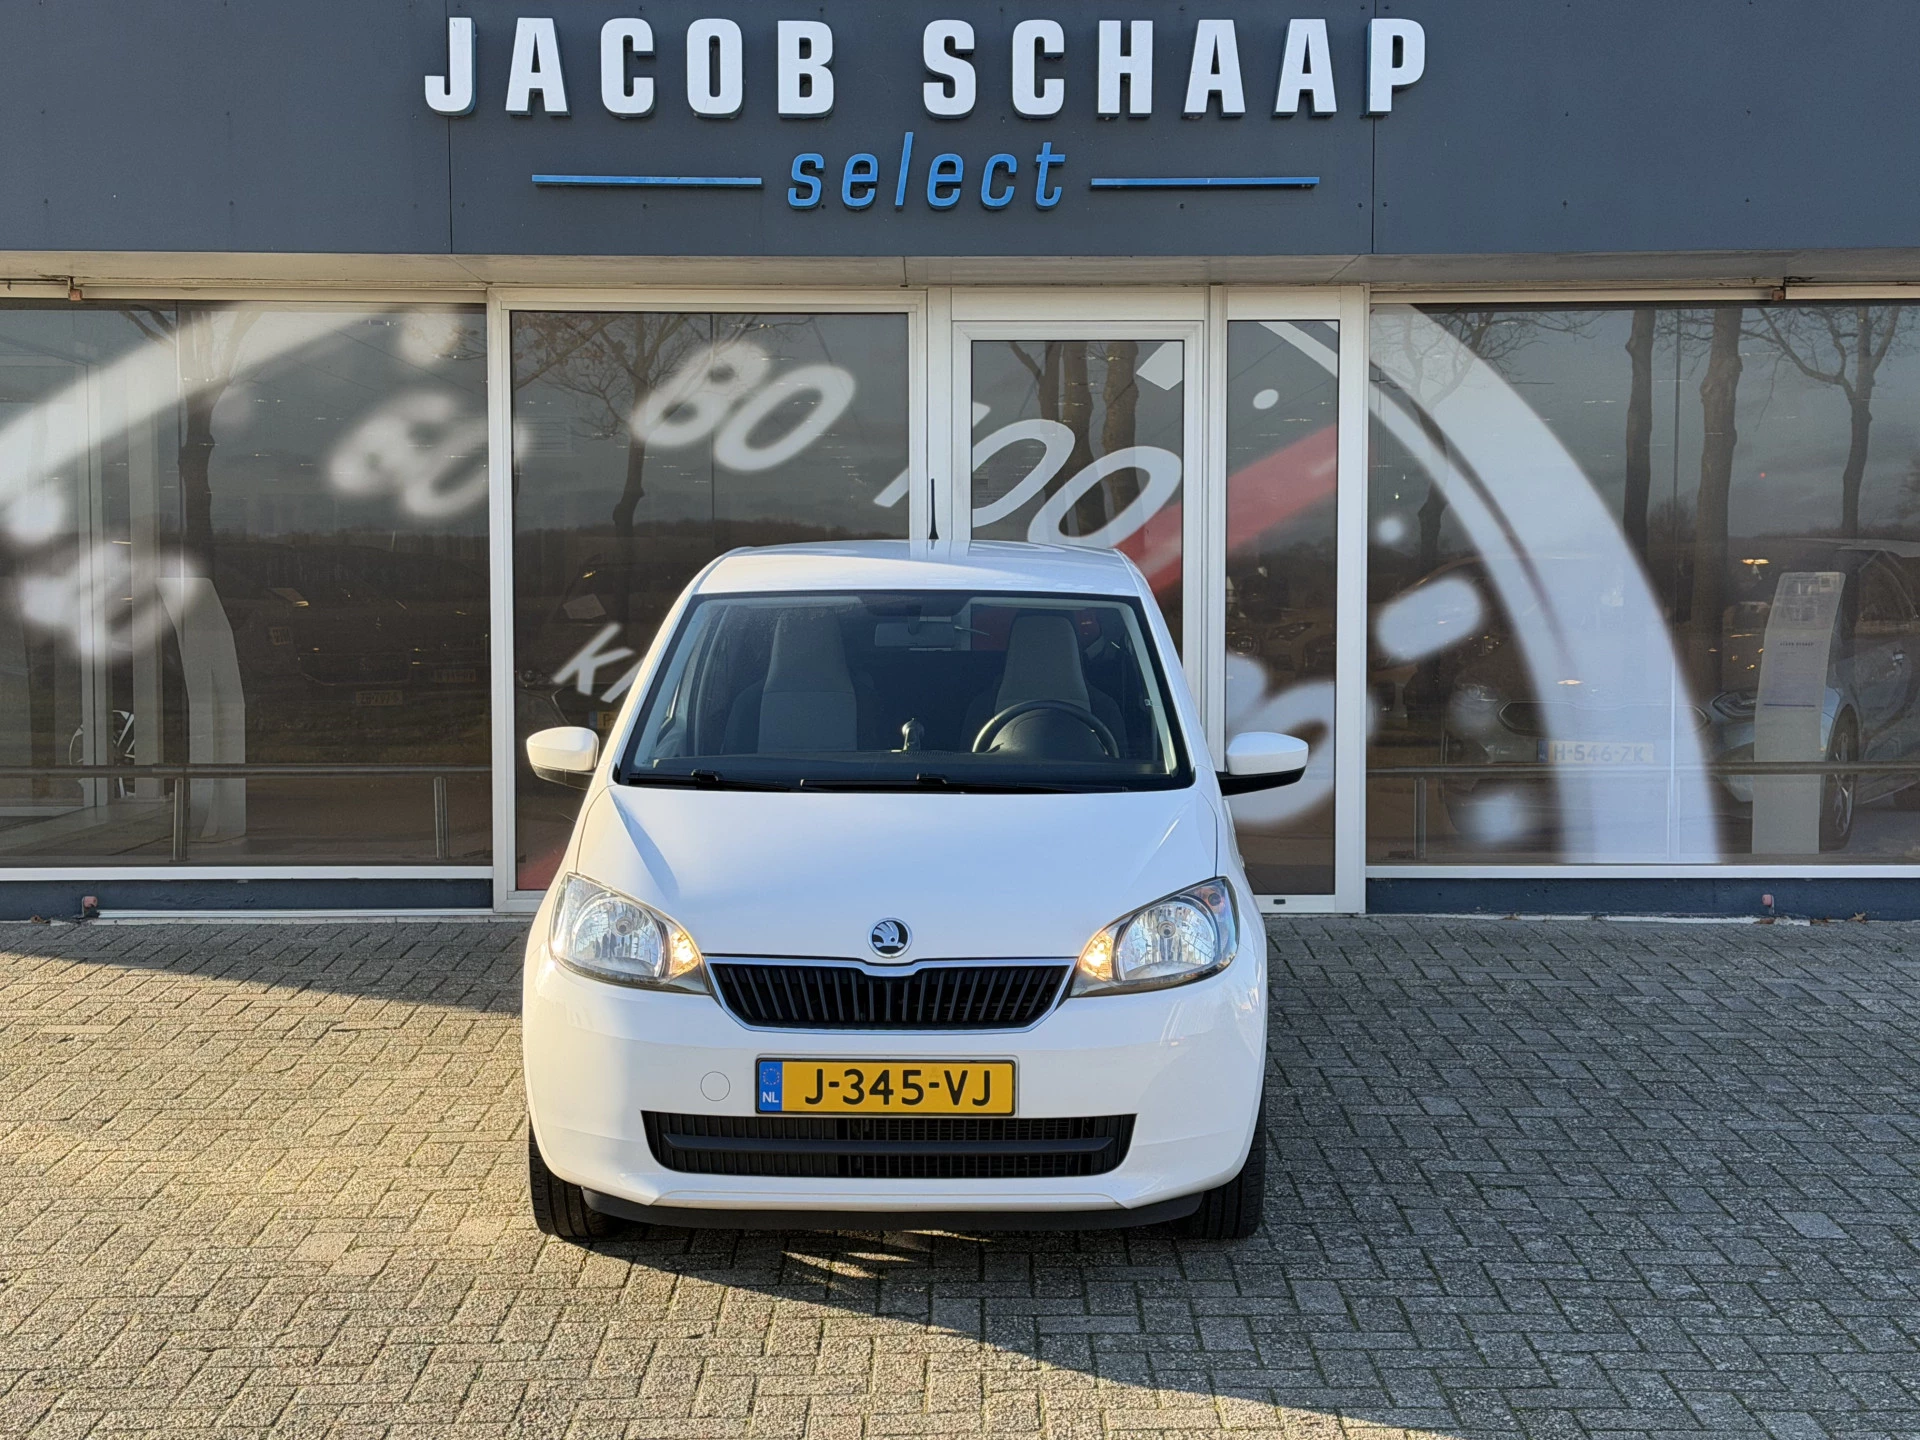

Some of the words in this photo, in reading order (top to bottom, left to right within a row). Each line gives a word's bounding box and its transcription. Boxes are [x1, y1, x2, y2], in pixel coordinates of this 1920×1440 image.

[424, 17, 836, 117] JACOB
[922, 18, 1427, 119] SCHAAP
[787, 131, 1066, 210] select
[631, 340, 856, 472] 80
[762, 1091, 780, 1104] NL
[804, 1068, 991, 1106] J-345-VJ
